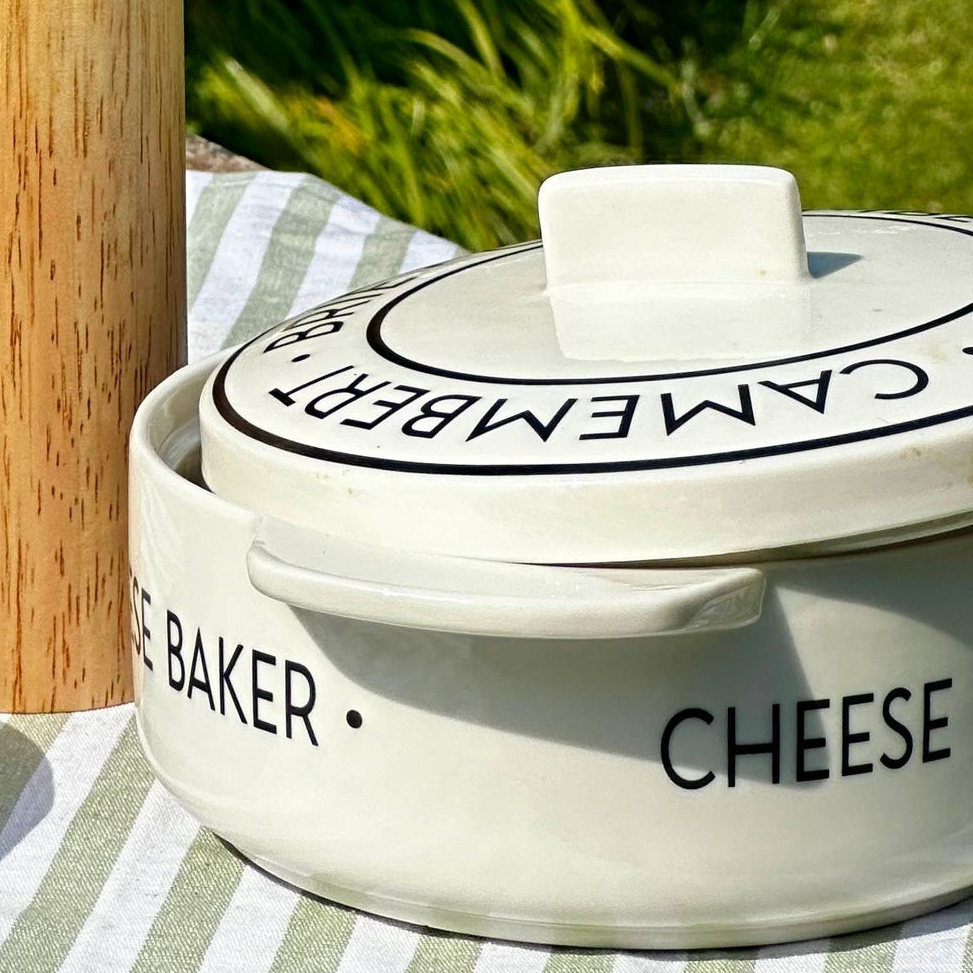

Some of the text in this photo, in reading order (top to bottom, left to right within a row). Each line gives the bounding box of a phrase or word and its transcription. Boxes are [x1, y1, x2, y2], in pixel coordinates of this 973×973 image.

[268, 358, 929, 442] CAMEMBERT
[130, 568, 319, 747] SE BAKER
[660, 677, 953, 790] CHEESE
